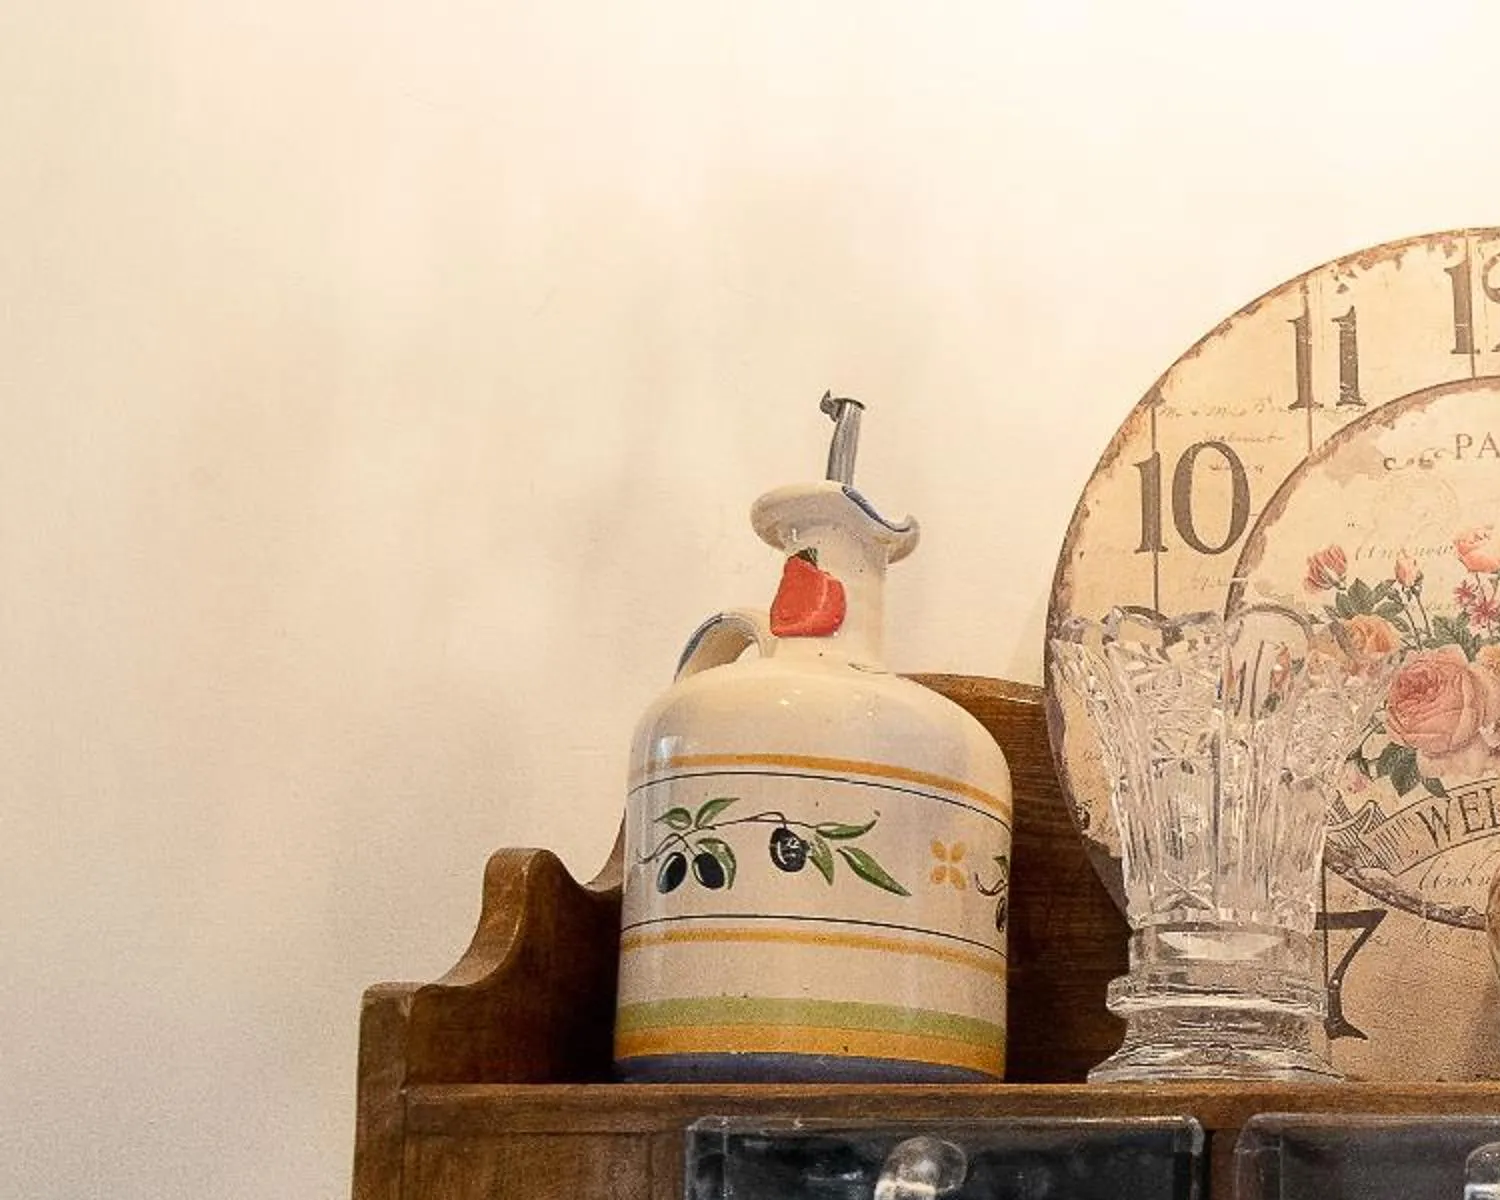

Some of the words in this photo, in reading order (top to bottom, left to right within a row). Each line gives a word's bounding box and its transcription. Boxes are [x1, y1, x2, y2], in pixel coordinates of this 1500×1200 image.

[1288, 304, 1367, 410] 11
[1133, 441, 1250, 555] 10
[1314, 909, 1388, 1041] 7
